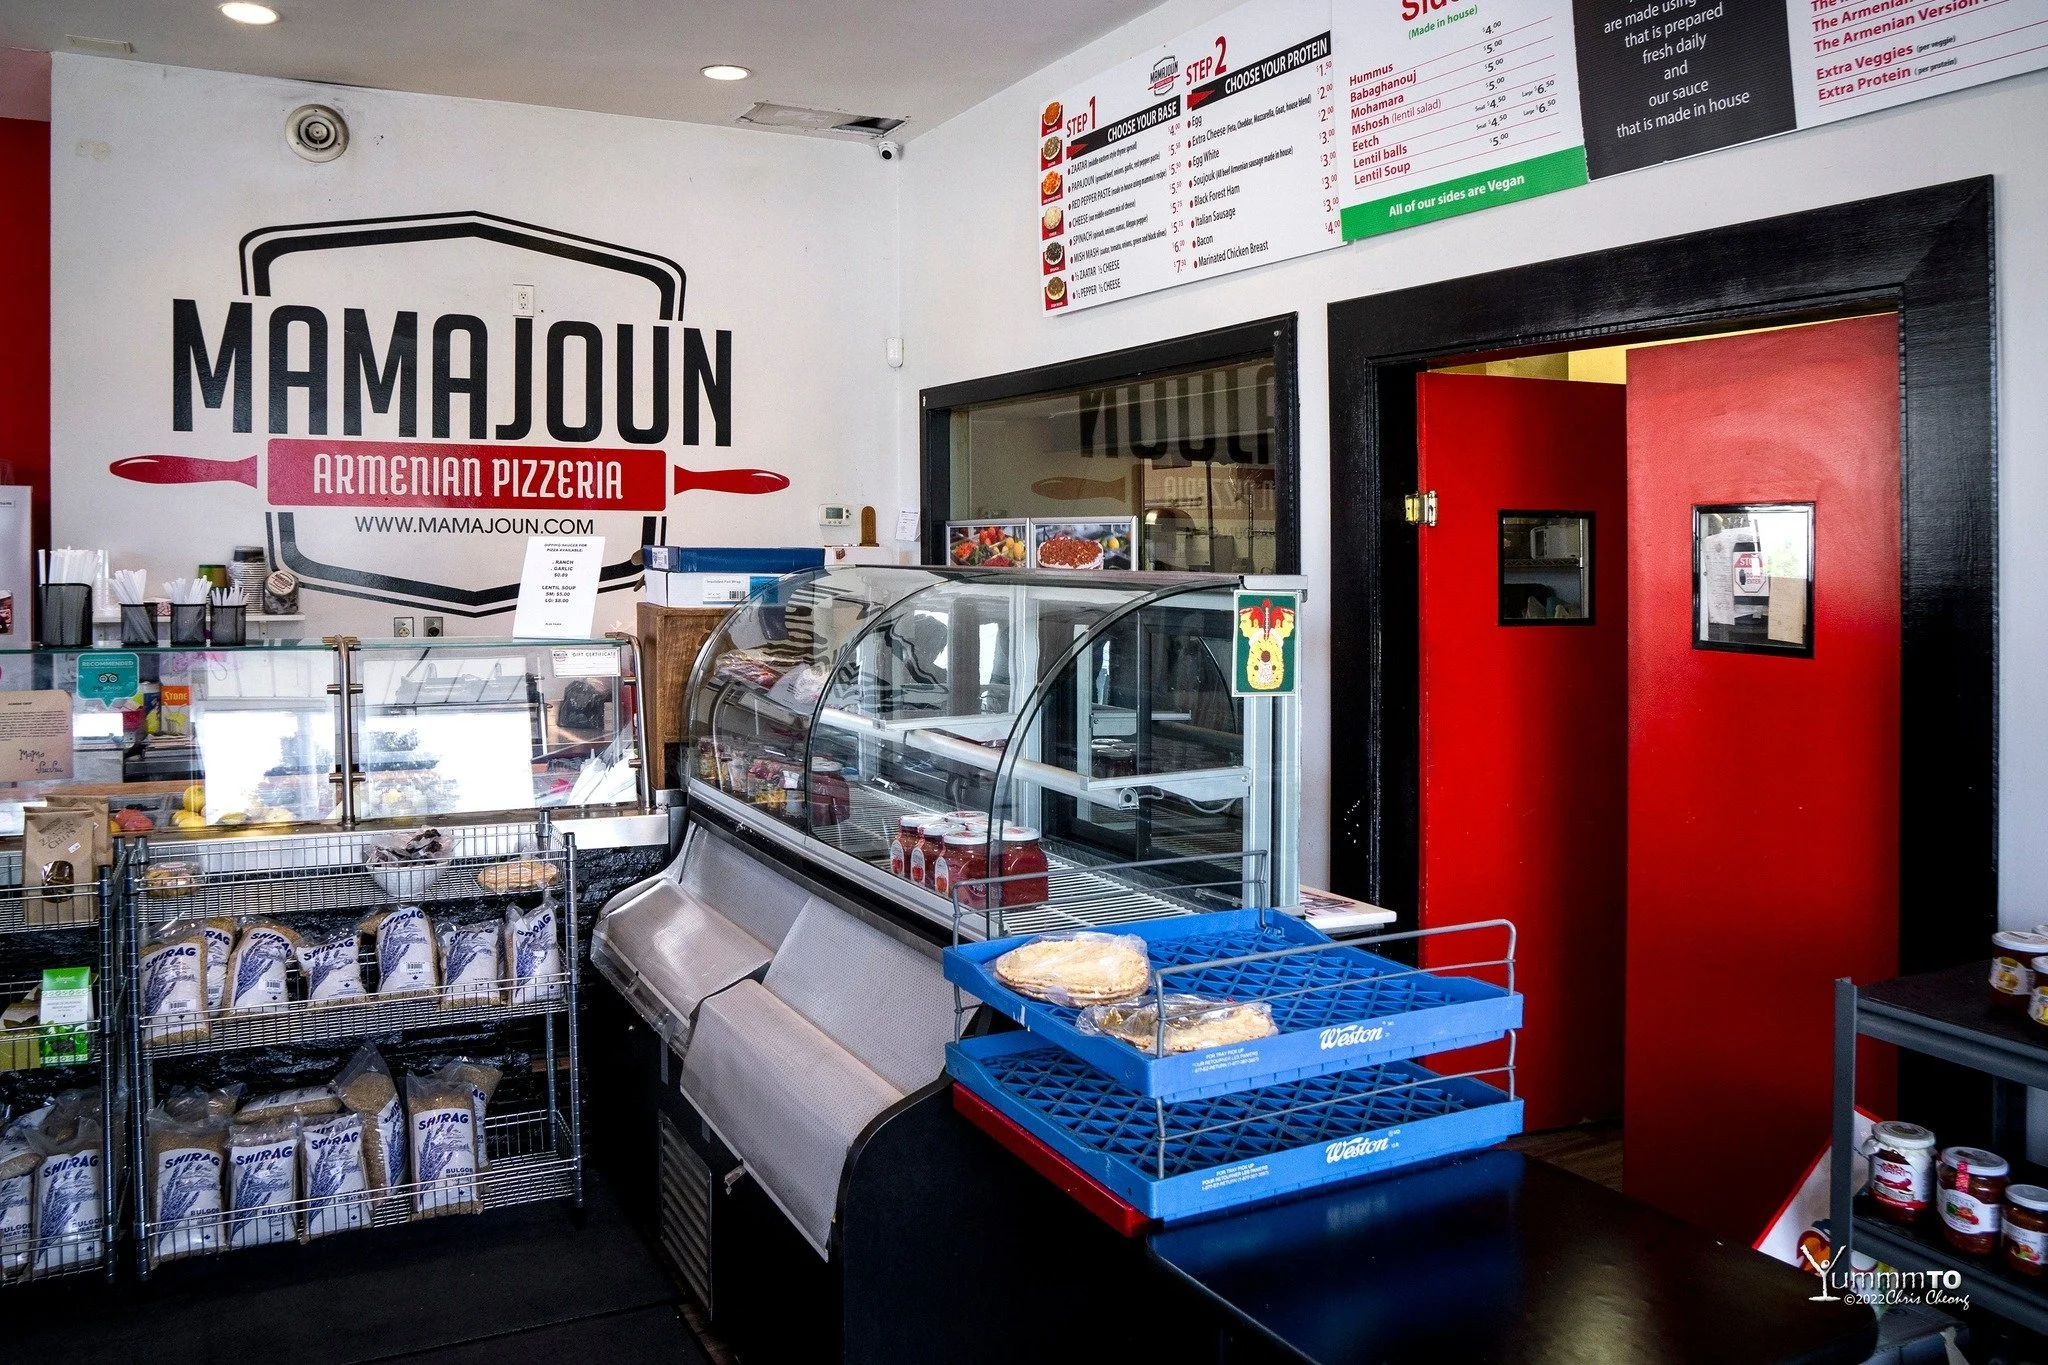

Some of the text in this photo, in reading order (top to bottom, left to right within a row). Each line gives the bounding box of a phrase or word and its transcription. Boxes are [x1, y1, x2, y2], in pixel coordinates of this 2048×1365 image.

[1408, 23, 1435, 40] (Made
[1437, 19, 1445, 28] in
[1447, 5, 1478, 24] house)
[1604, 4, 1659, 34] are made
[1625, 2, 1724, 48] that is prepared
[1812, 15, 1838, 32] The
[1814, 36, 1840, 52] The
[1843, 14, 1915, 44] Armenian
[1186, 35, 1227, 86] STEP 2
[1643, 32, 1707, 64] fresh daily
[1225, 37, 1328, 95] CHOOSE YOUR PROTEIN
[1349, 62, 1394, 87] Hummus
[1664, 60, 1688, 80] and
[1817, 64, 1852, 81] Extra
[1855, 45, 1913, 69] Veggies
[1350, 70, 1417, 102] Babaghanouj
[1648, 80, 1709, 107] our sauce
[1818, 84, 1854, 101] Extra
[1857, 67, 1911, 90] Protein
[1066, 95, 1096, 138] STEP 1
[1351, 93, 1404, 119] Mohamara
[1352, 99, 1442, 136] Mshosh (lentil salad)
[1617, 91, 1750, 138] that is made in house
[1107, 101, 1177, 142] CHOOSE YOUR BASE
[1191, 115, 1203, 129] Egg
[1192, 132, 1206, 147] Extra
[1206, 126, 1226, 141] Cheese
[1352, 136, 1380, 152] Eetch
[1192, 148, 1220, 169] Egg White
[1353, 143, 1408, 169] Lentil balls
[1193, 169, 1216, 186] Soujouk
[1354, 161, 1411, 186] Lentil Soup
[1080, 191, 1097, 207] PEPPER
[1097, 186, 1111, 201] PASTE
[1194, 183, 1240, 207] Black Forest Ham
[1389, 174, 1525, 217] All of our sides are Vegan
[1072, 213, 1089, 228] CHEESE
[1195, 206, 1236, 227] Italian Sausage
[1072, 231, 1093, 246] SPINACH
[1196, 234, 1214, 248] Bacon
[1085, 246, 1100, 260] MASH
[1198, 240, 1269, 267] Marinated Chicken Breast
[1103, 259, 1120, 273] CHEESE
[1080, 278, 1121, 297] PEPPER CHEESE
[172, 298, 732, 447] MAMAJOUN
[313, 452, 624, 500] ARMENIAN PIZZERIA
[354, 515, 594, 536] WWW.MAMAJOUN.COM
[251, 932, 293, 959] SHIRAG
[303, 938, 354, 961] SHIRAG
[145, 947, 196, 971] SHIRAG
[1319, 1024, 1384, 1050] Weston
[418, 1112, 469, 1130] SHIRAG
[311, 1131, 359, 1150] SHIRAG
[1325, 1136, 1389, 1164] Weston
[43, 1155, 99, 1178] SHIRAG
[165, 1152, 220, 1169] SHIRAG
[236, 1145, 293, 1165] SHIRAG
